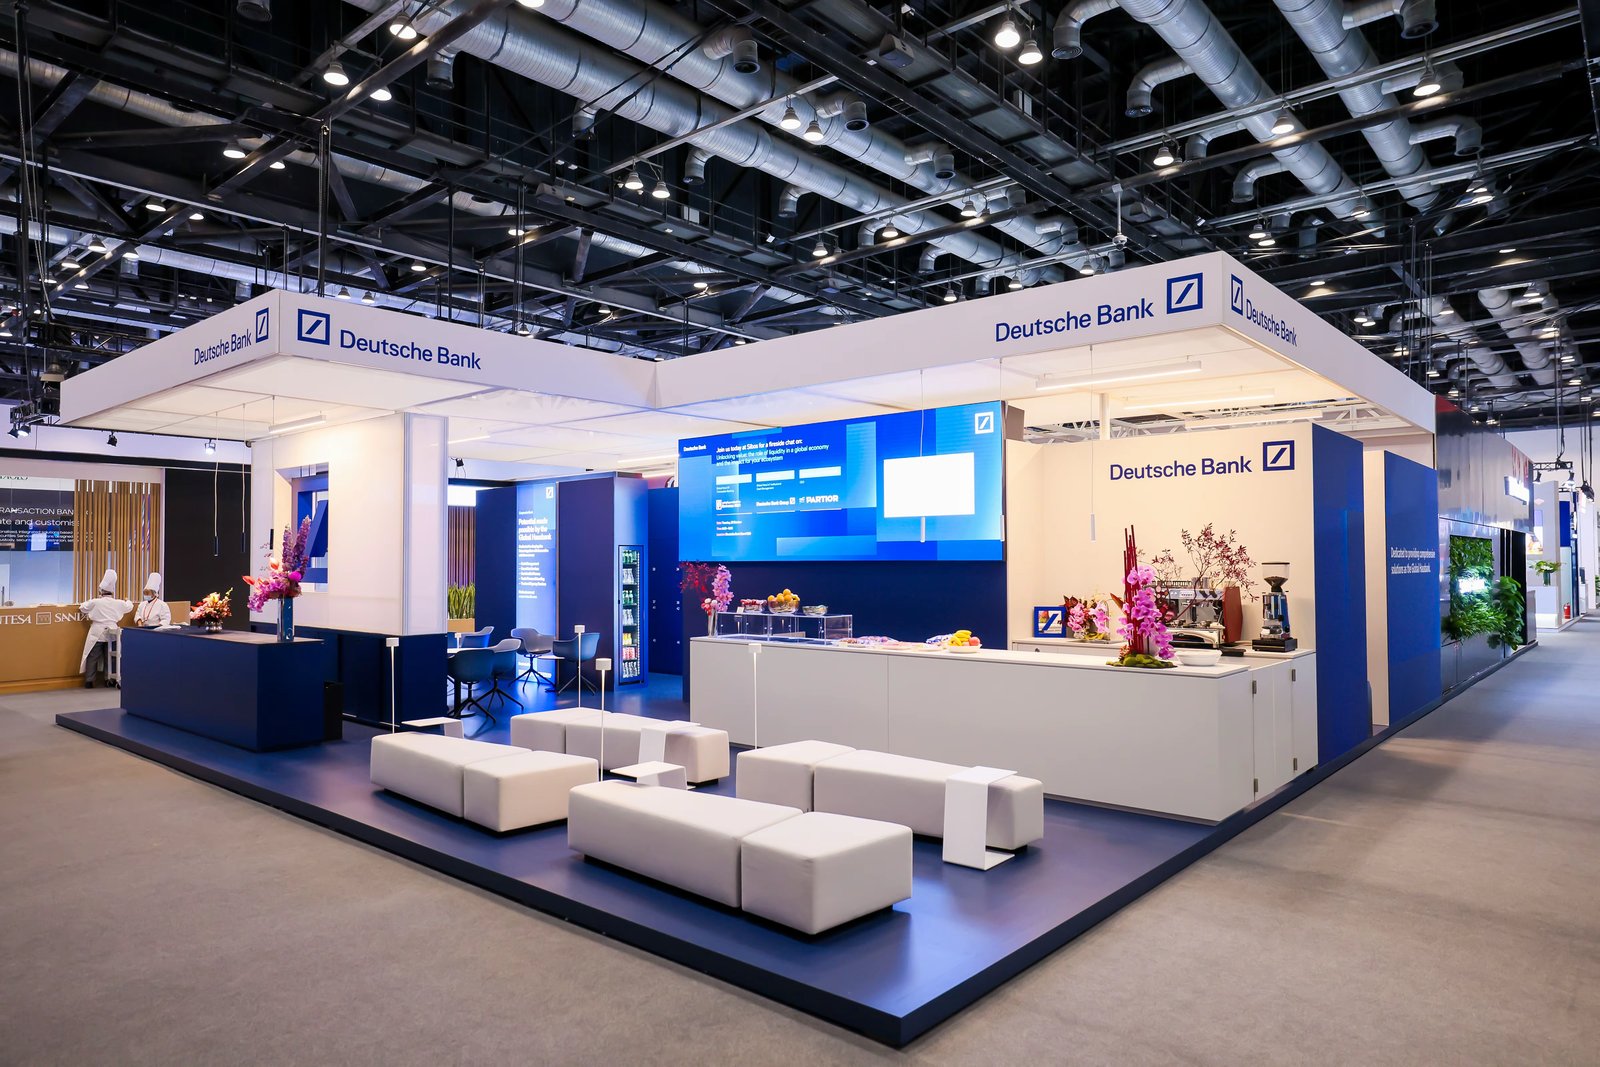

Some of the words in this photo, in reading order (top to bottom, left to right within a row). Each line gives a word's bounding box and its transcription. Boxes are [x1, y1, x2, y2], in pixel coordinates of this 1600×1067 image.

[996, 310, 1092, 342] Deutsche
[1097, 298, 1154, 325] Bank
[1246, 298, 1280, 336] Deutsche
[1281, 321, 1297, 347] Bank
[194, 336, 230, 366] Deutsche
[230, 328, 252, 353] Bank
[340, 328, 432, 362] Deutsche
[437, 346, 481, 370] Bank
[794, 445, 808, 453] global
[1110, 460, 1196, 480] Deutsche
[1202, 456, 1252, 475] Bank
[806, 495, 838, 503] PARTIOR
[0, 615, 31, 624] TESA
